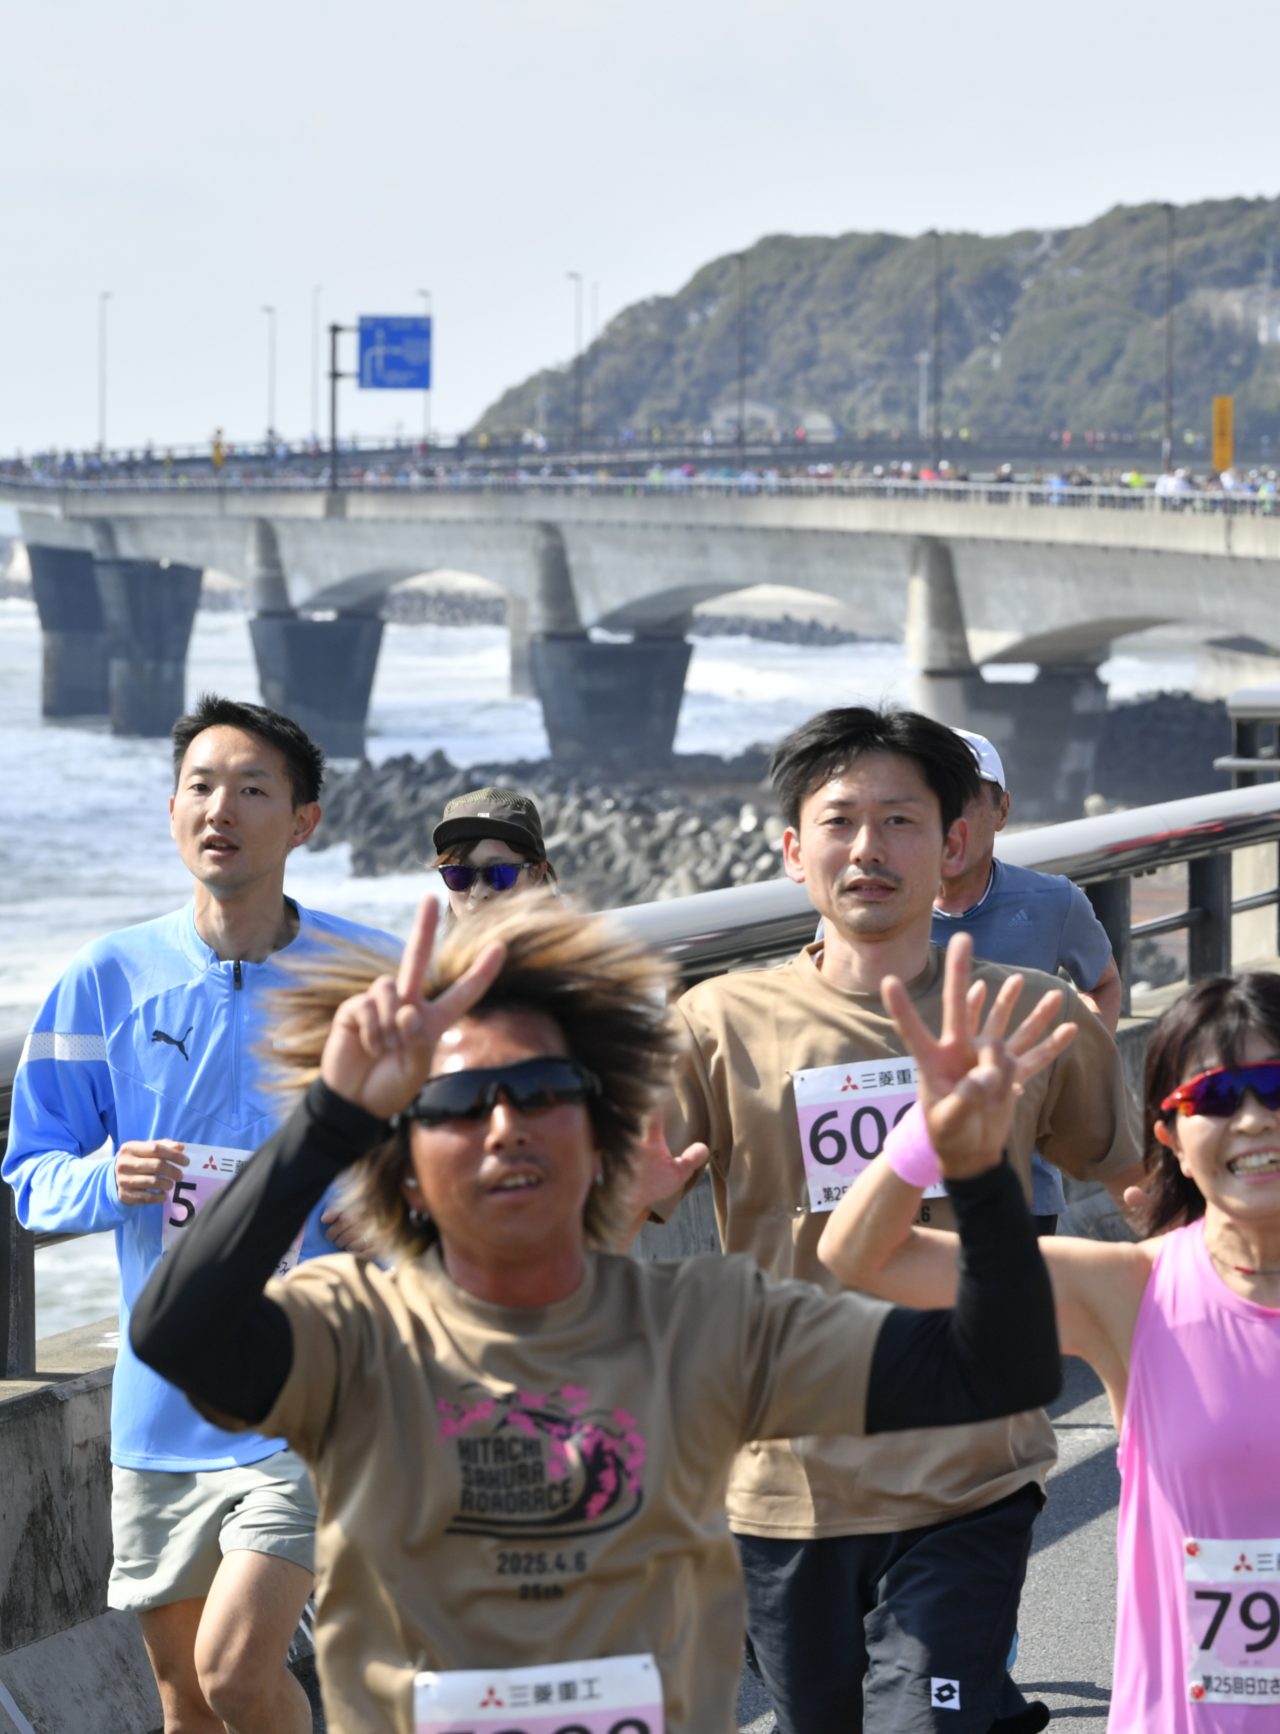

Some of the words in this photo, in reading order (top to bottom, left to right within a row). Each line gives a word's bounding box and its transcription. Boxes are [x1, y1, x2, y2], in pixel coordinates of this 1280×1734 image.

[861, 1068, 920, 1090] 三菱重
[809, 1100, 917, 1166] 60
[457, 1435, 542, 1465] HITACHI
[509, 1677, 603, 1708] 三菱重工
